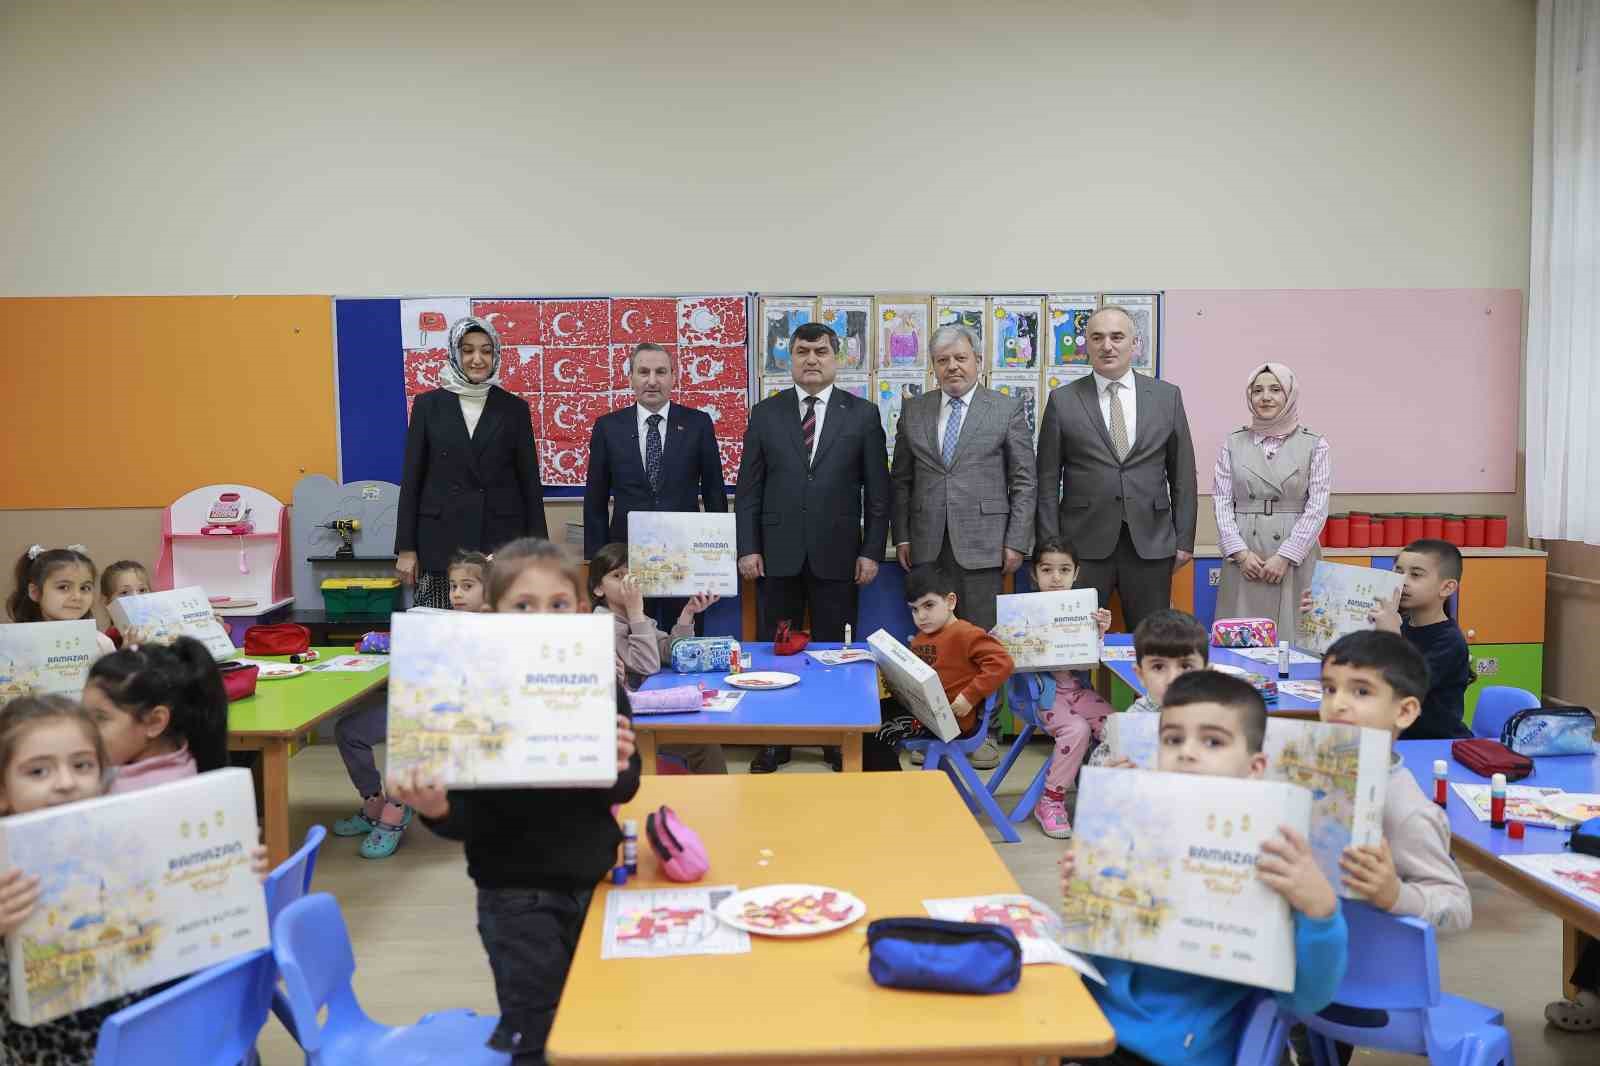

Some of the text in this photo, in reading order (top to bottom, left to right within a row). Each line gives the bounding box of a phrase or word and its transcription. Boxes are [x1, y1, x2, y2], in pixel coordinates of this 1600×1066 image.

[693, 541, 728, 549] RAMAZAN
[47, 653, 89, 664] RAMAZAN
[526, 673, 599, 684] RAMAZAN
[168, 840, 242, 869] RAMAZAN
